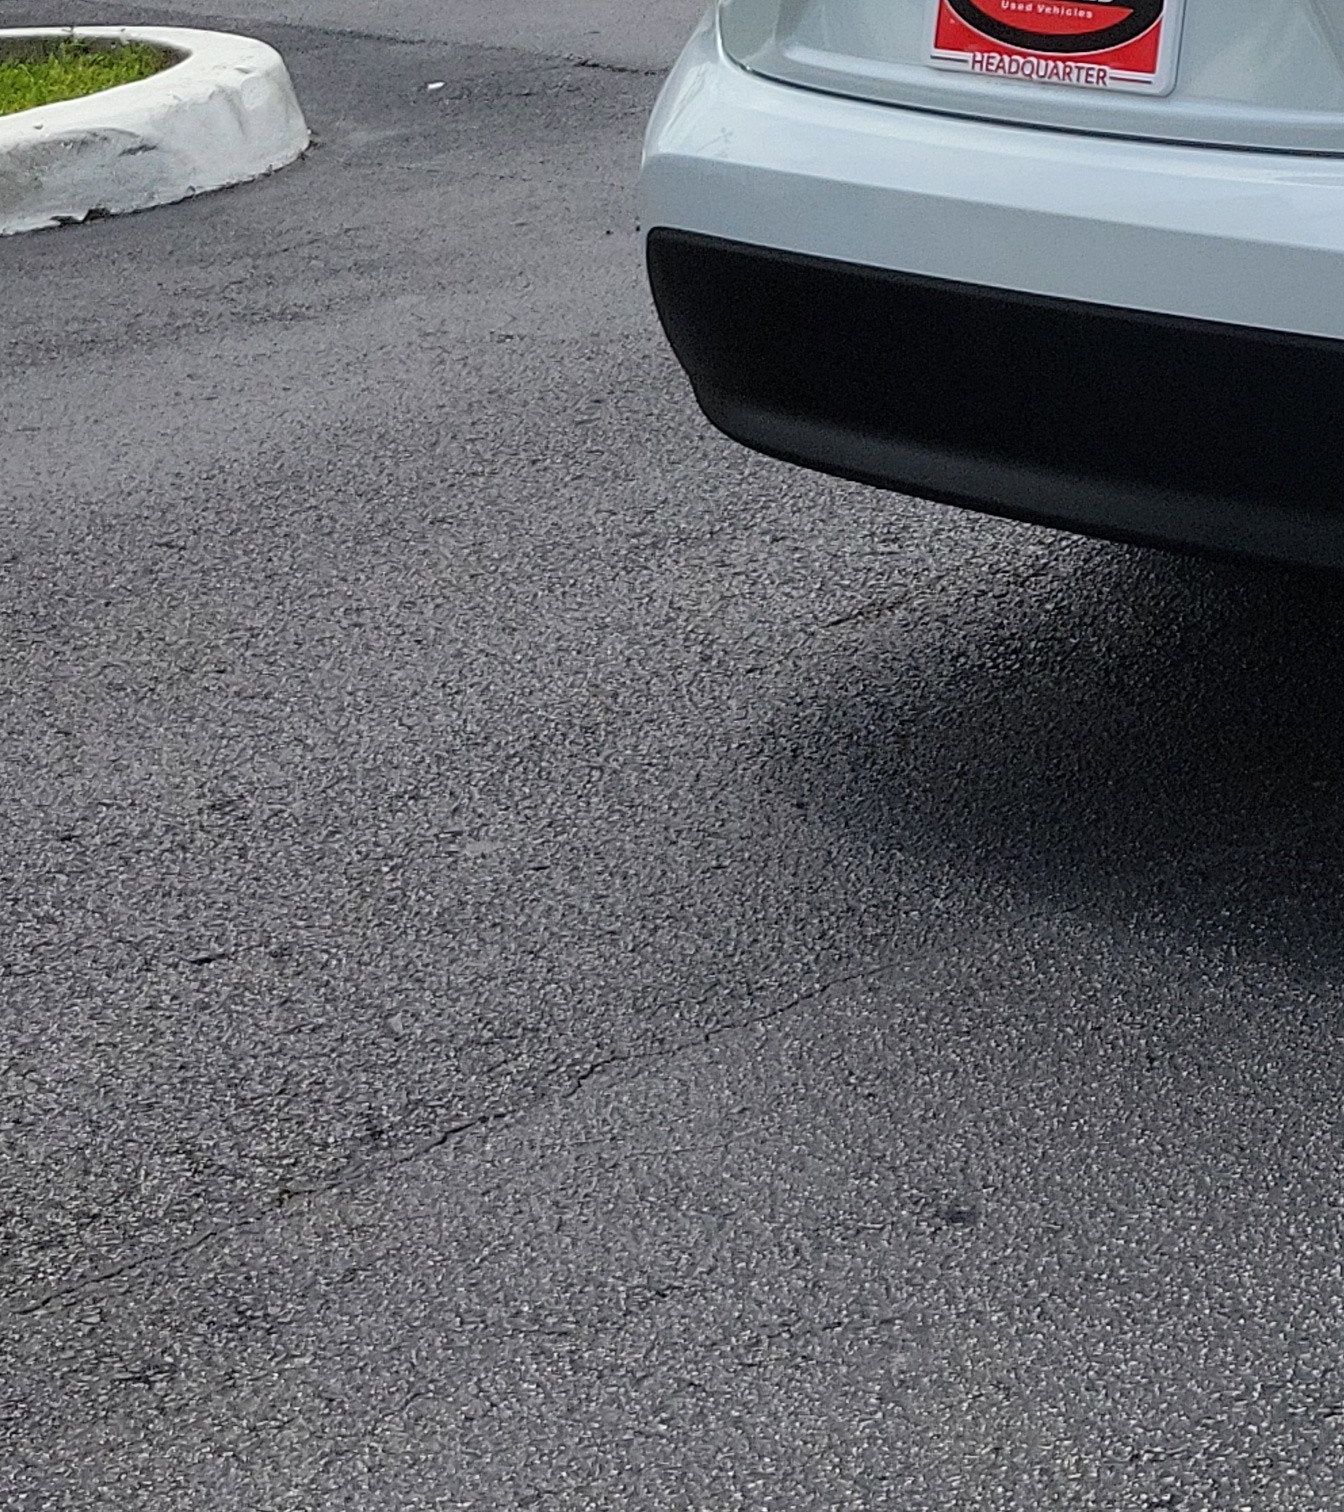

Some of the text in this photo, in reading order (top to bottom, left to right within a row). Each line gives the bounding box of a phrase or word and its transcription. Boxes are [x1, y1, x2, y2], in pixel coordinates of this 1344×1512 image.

[1000, 0, 1094, 20] Used Vehicles
[970, 53, 1108, 87] HEADQUARTER
